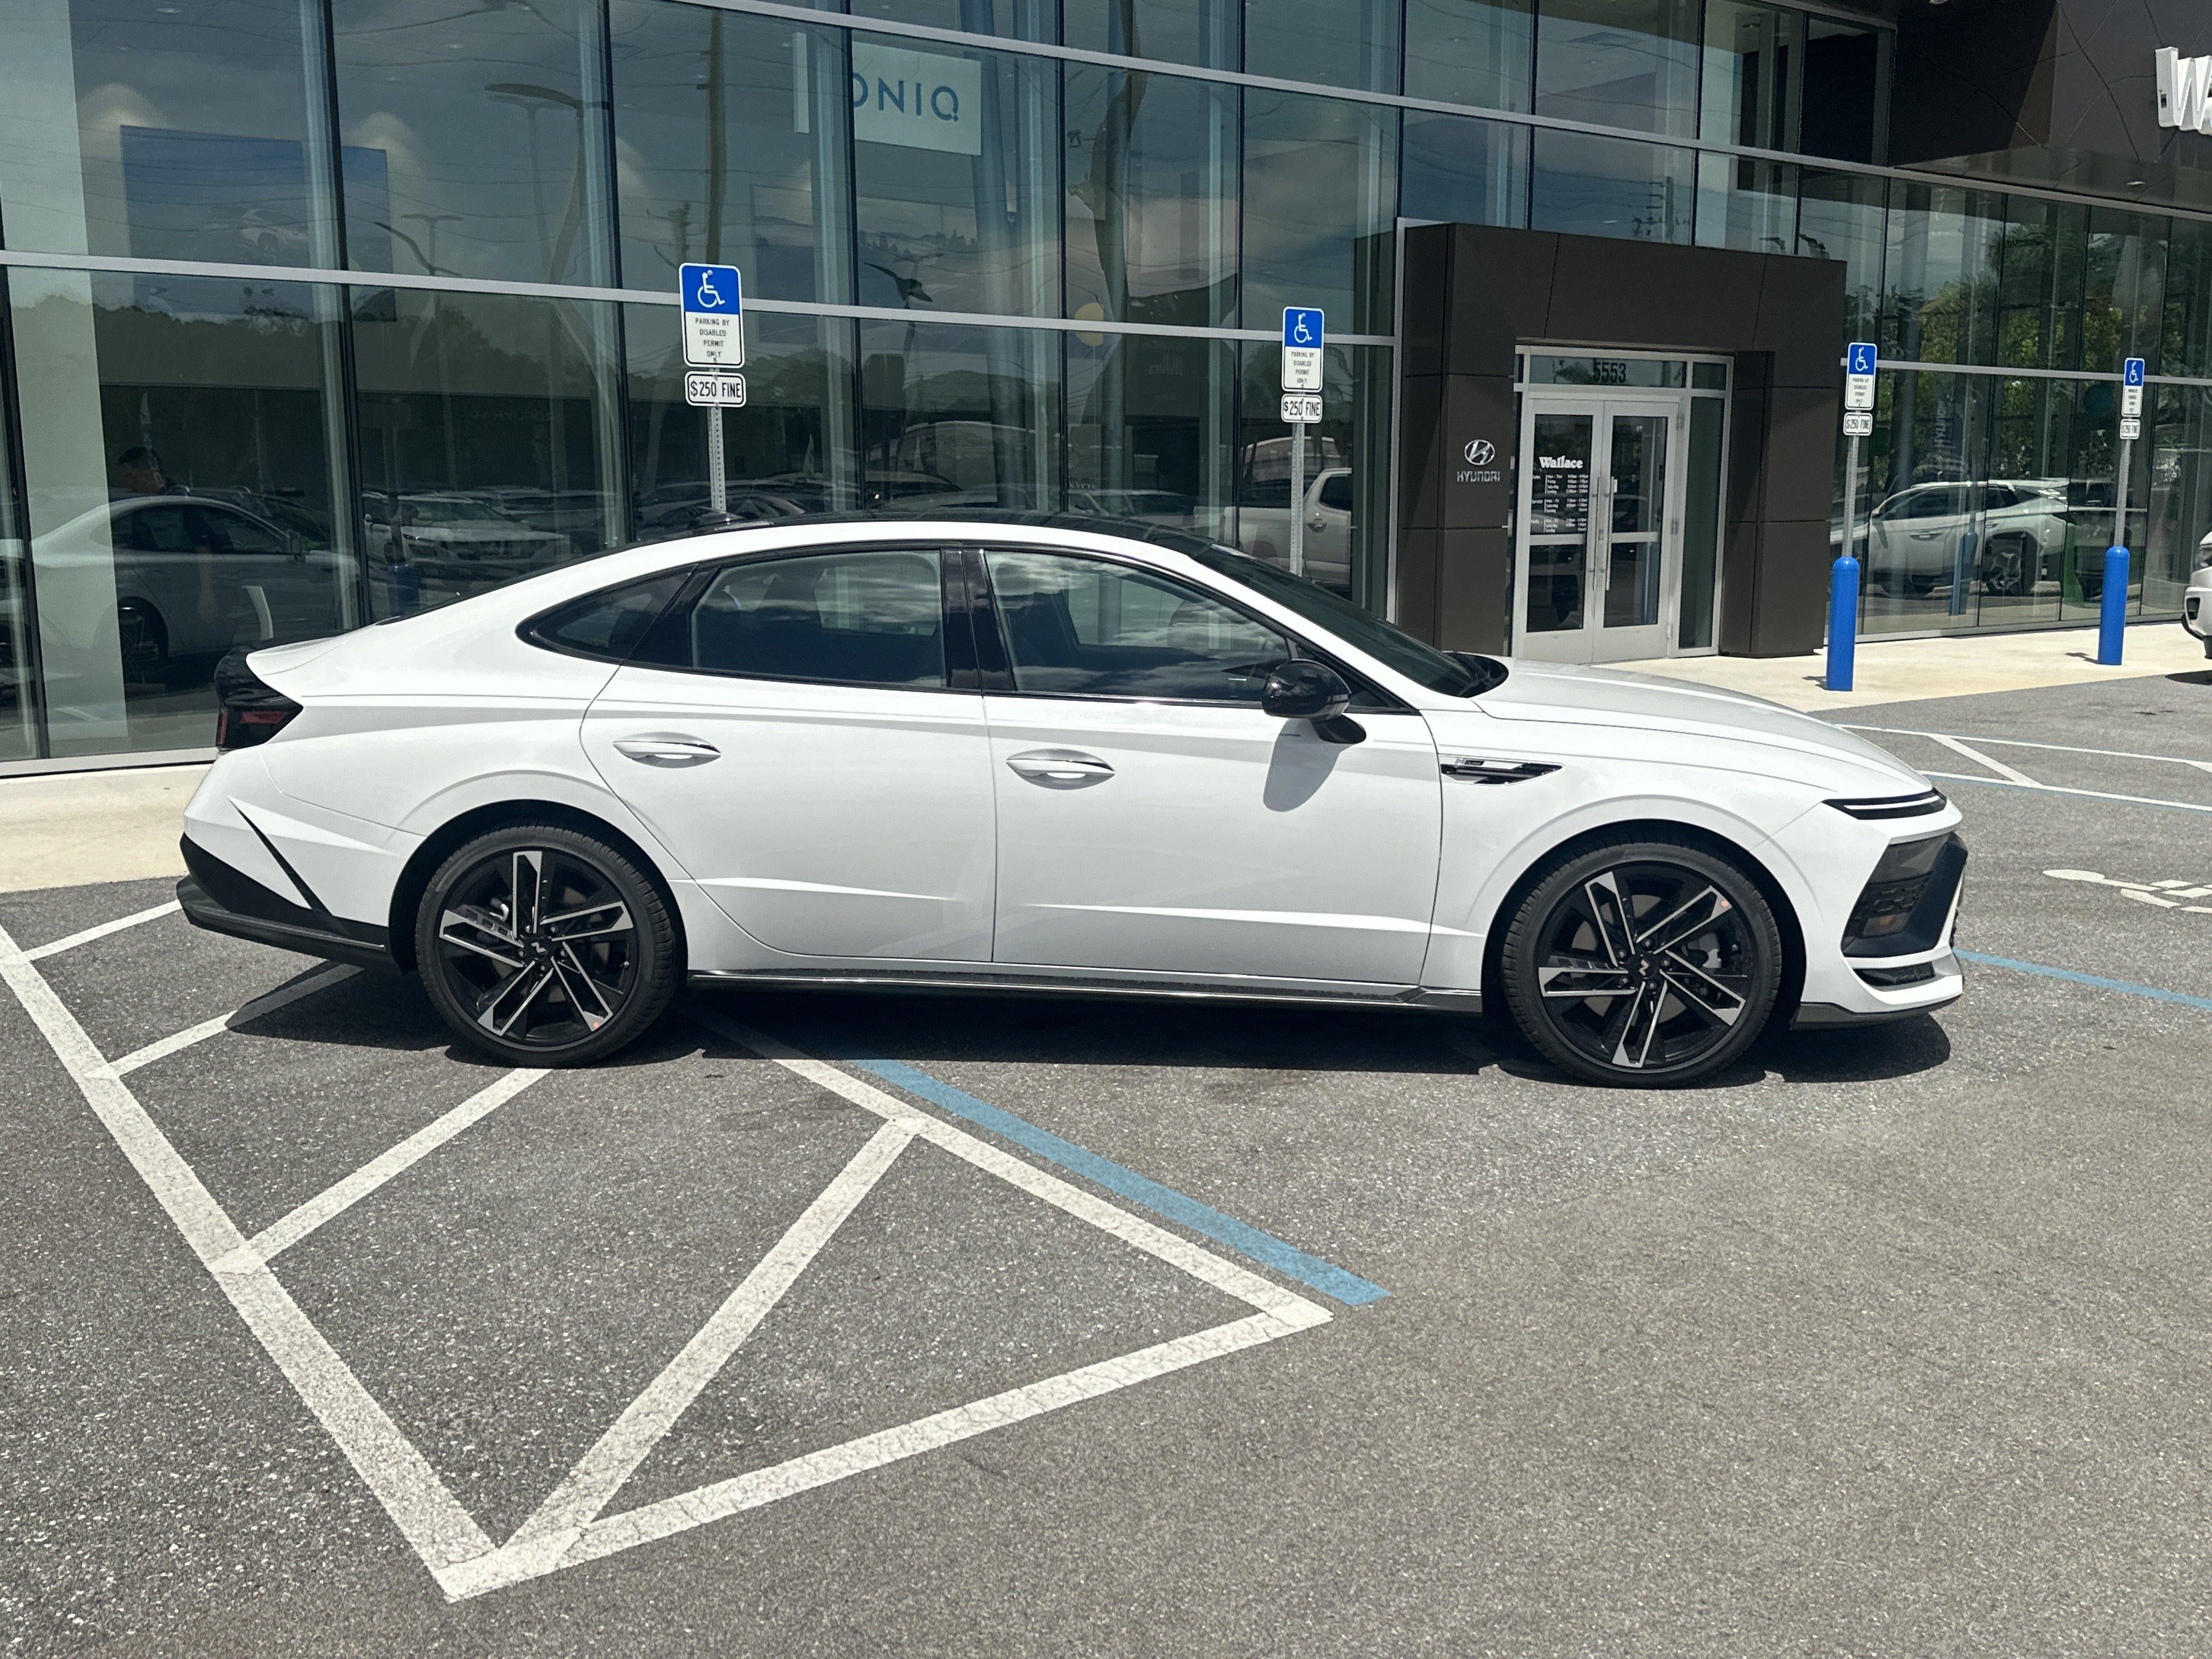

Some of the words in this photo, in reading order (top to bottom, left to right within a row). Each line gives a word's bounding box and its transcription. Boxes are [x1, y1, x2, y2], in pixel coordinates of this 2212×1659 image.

[1593, 360, 1626, 383] 5553
[690, 380, 716, 397] $250
[722, 382, 741, 398] FINE
[1284, 400, 1303, 416] $250
[1306, 402, 1320, 416] FINE
[1539, 455, 1583, 469] Wallace
[1457, 471, 1500, 482] HYUNDAI
